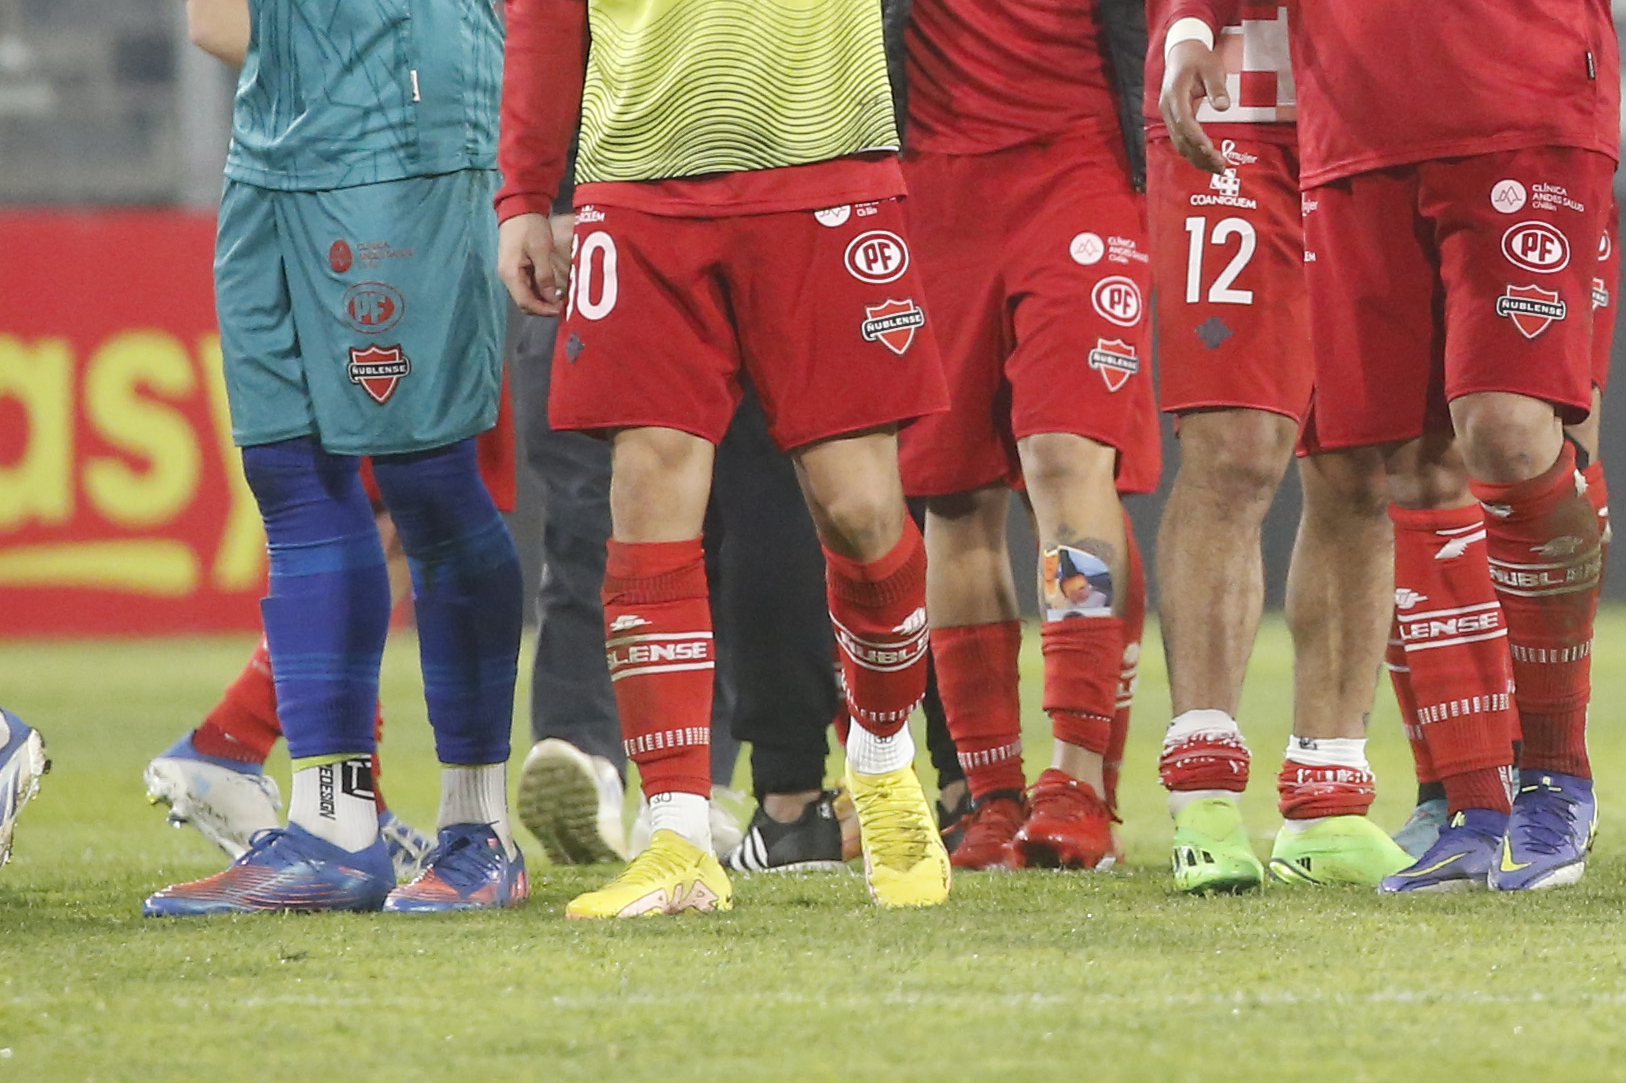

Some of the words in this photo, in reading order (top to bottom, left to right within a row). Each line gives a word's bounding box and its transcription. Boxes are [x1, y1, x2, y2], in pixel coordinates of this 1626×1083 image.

[1190, 195, 1257, 209] COANIQUEM
[862, 241, 892, 271] PF
[1185, 216, 1257, 304] 12
[1521, 232, 1554, 262] PF
[566, 230, 618, 321] 0
[354, 292, 387, 324] PF
[1108, 287, 1133, 315] PF
[1400, 611, 1499, 640] LENSE
[607, 642, 707, 664] LENSE
